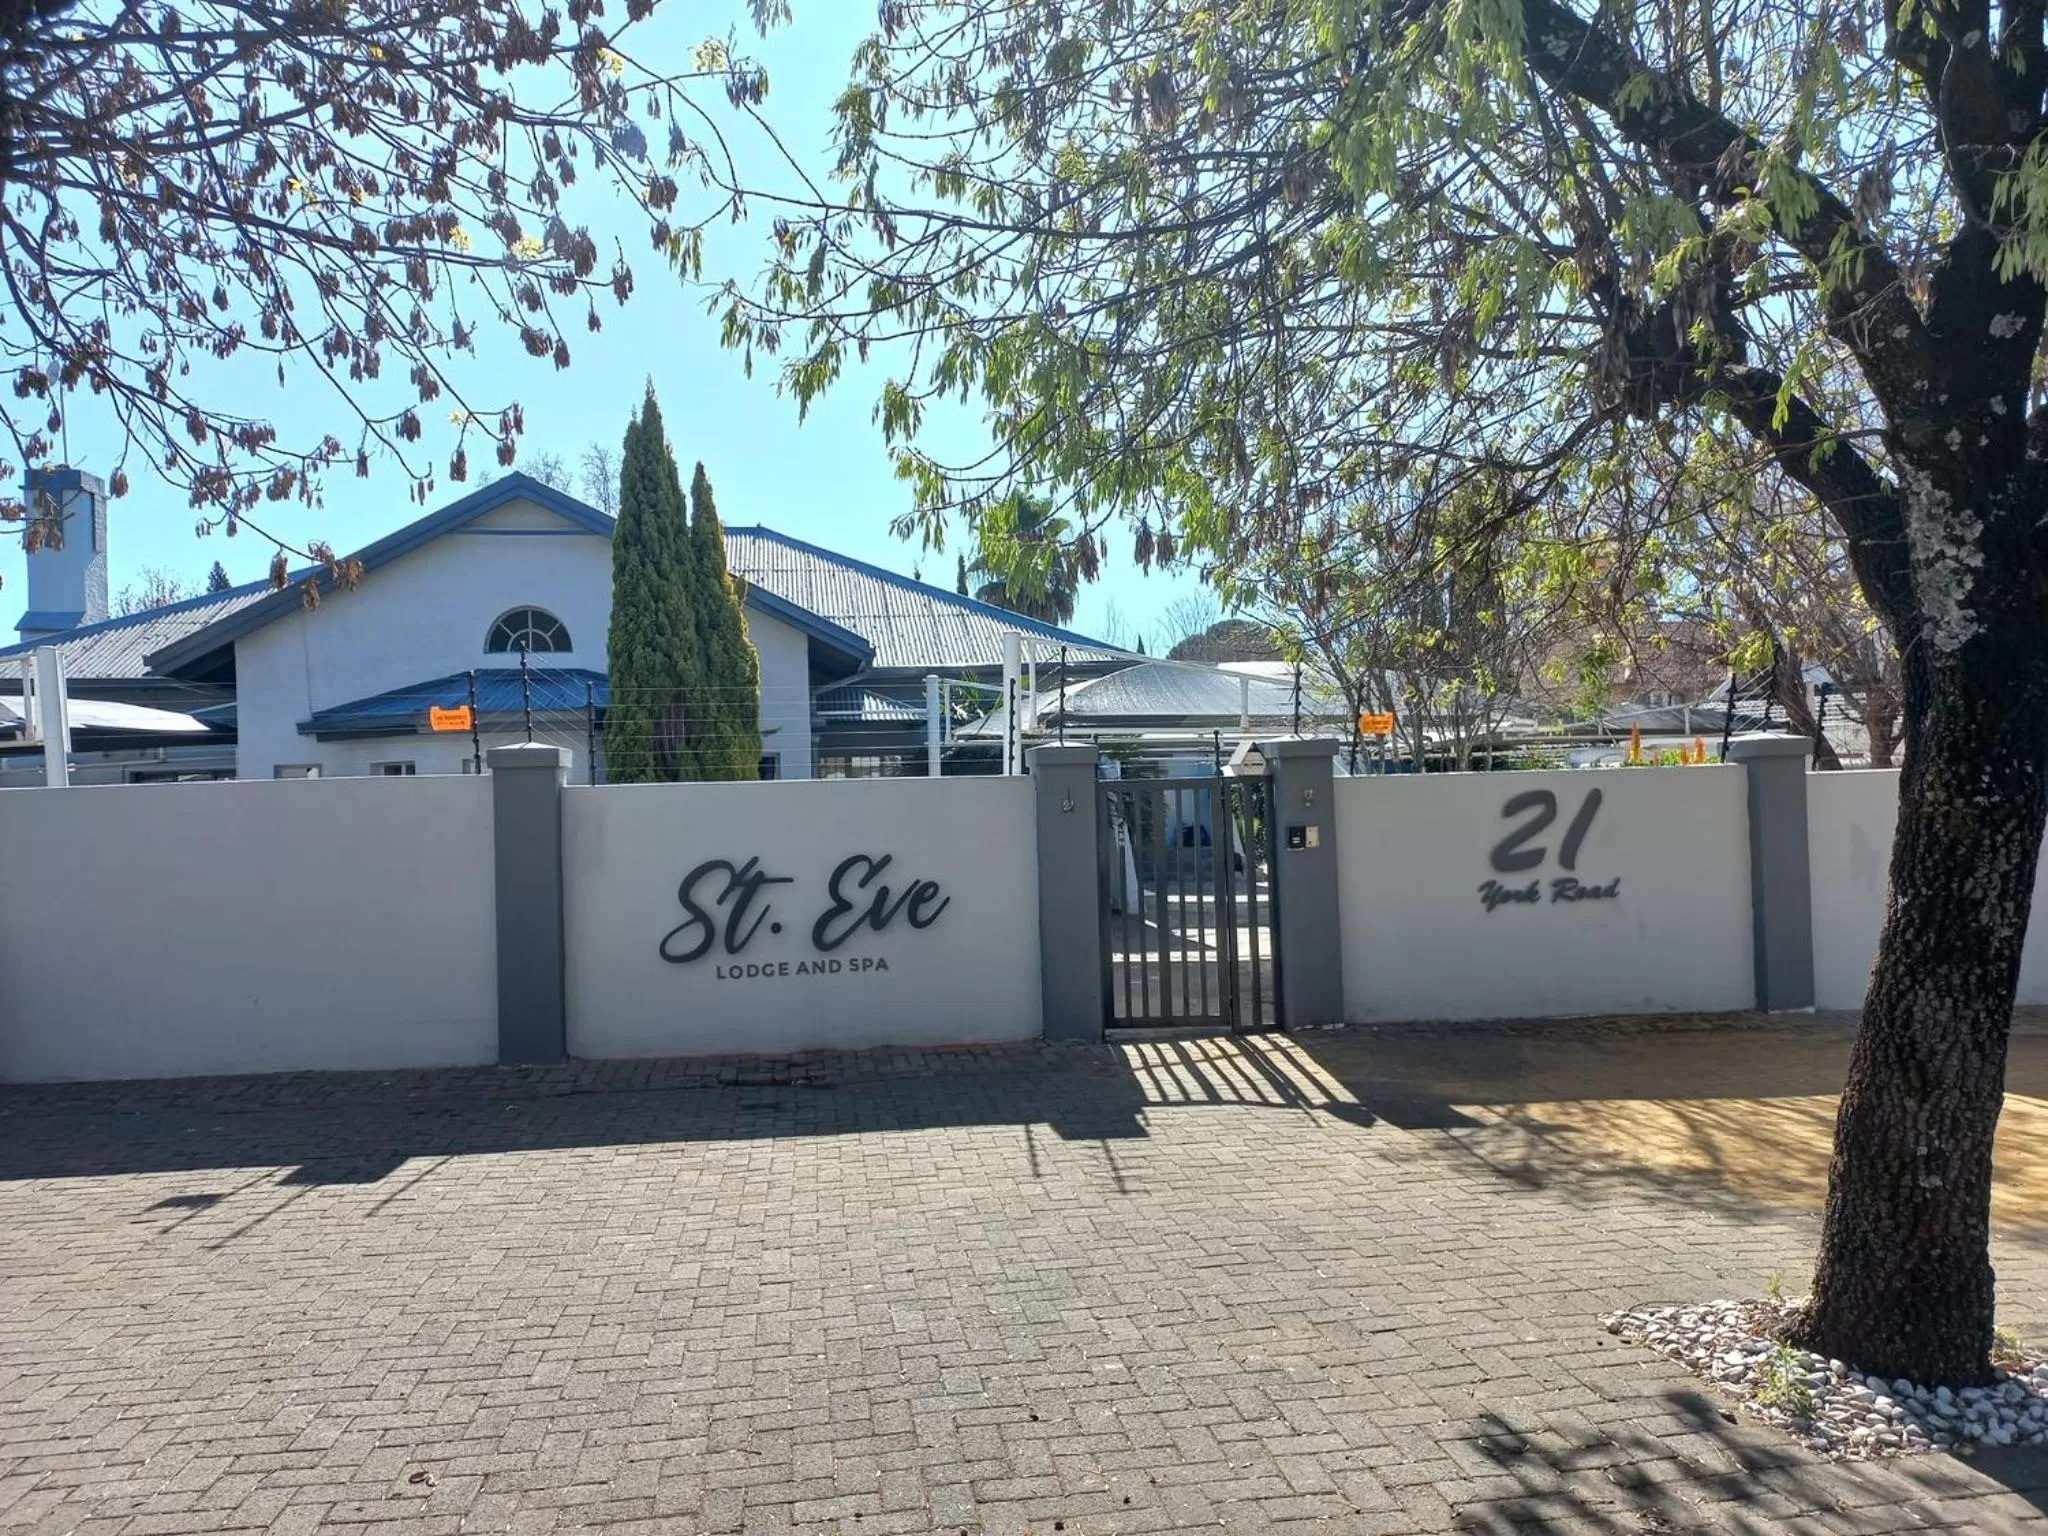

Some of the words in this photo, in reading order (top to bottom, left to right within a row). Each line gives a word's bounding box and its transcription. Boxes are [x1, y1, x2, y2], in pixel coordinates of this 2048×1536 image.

[1490, 787, 1602, 873] 21
[659, 855, 794, 965] St.
[811, 853, 951, 953] Eve
[1478, 879, 1541, 914] York
[1550, 877, 1621, 904] Road
[716, 963, 790, 980] LODGE
[795, 959, 842, 976] AND
[848, 957, 889, 973] SPA
